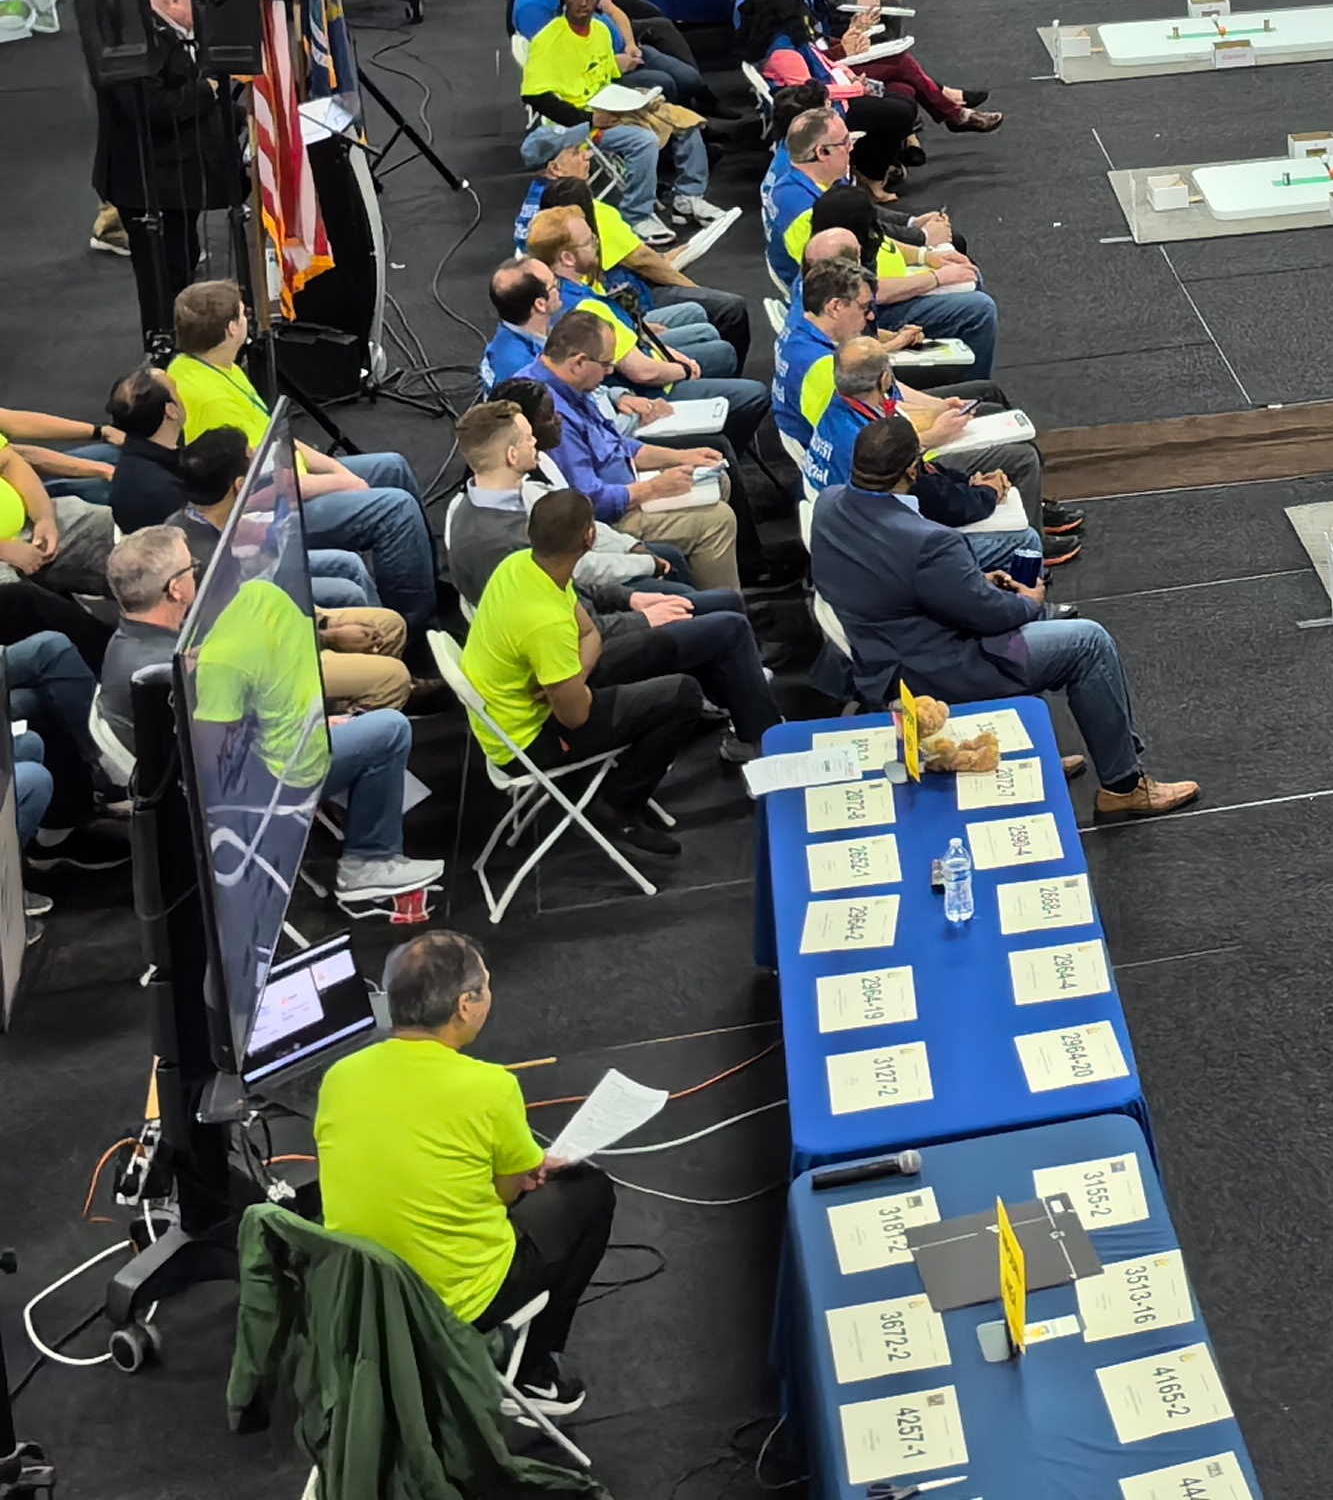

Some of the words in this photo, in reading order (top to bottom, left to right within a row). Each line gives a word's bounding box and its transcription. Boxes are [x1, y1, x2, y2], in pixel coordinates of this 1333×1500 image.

[876, 1056, 899, 1097] 3127-2
[1060, 1032, 1095, 1078] 2964-20
[1082, 1170, 1112, 1218] 3155-2
[1123, 1264, 1157, 1325] 3513-16
[879, 1310, 912, 1362] 3672-2
[1151, 1365, 1192, 1420] 4165-2
[895, 1406, 928, 1461] 4257-1
